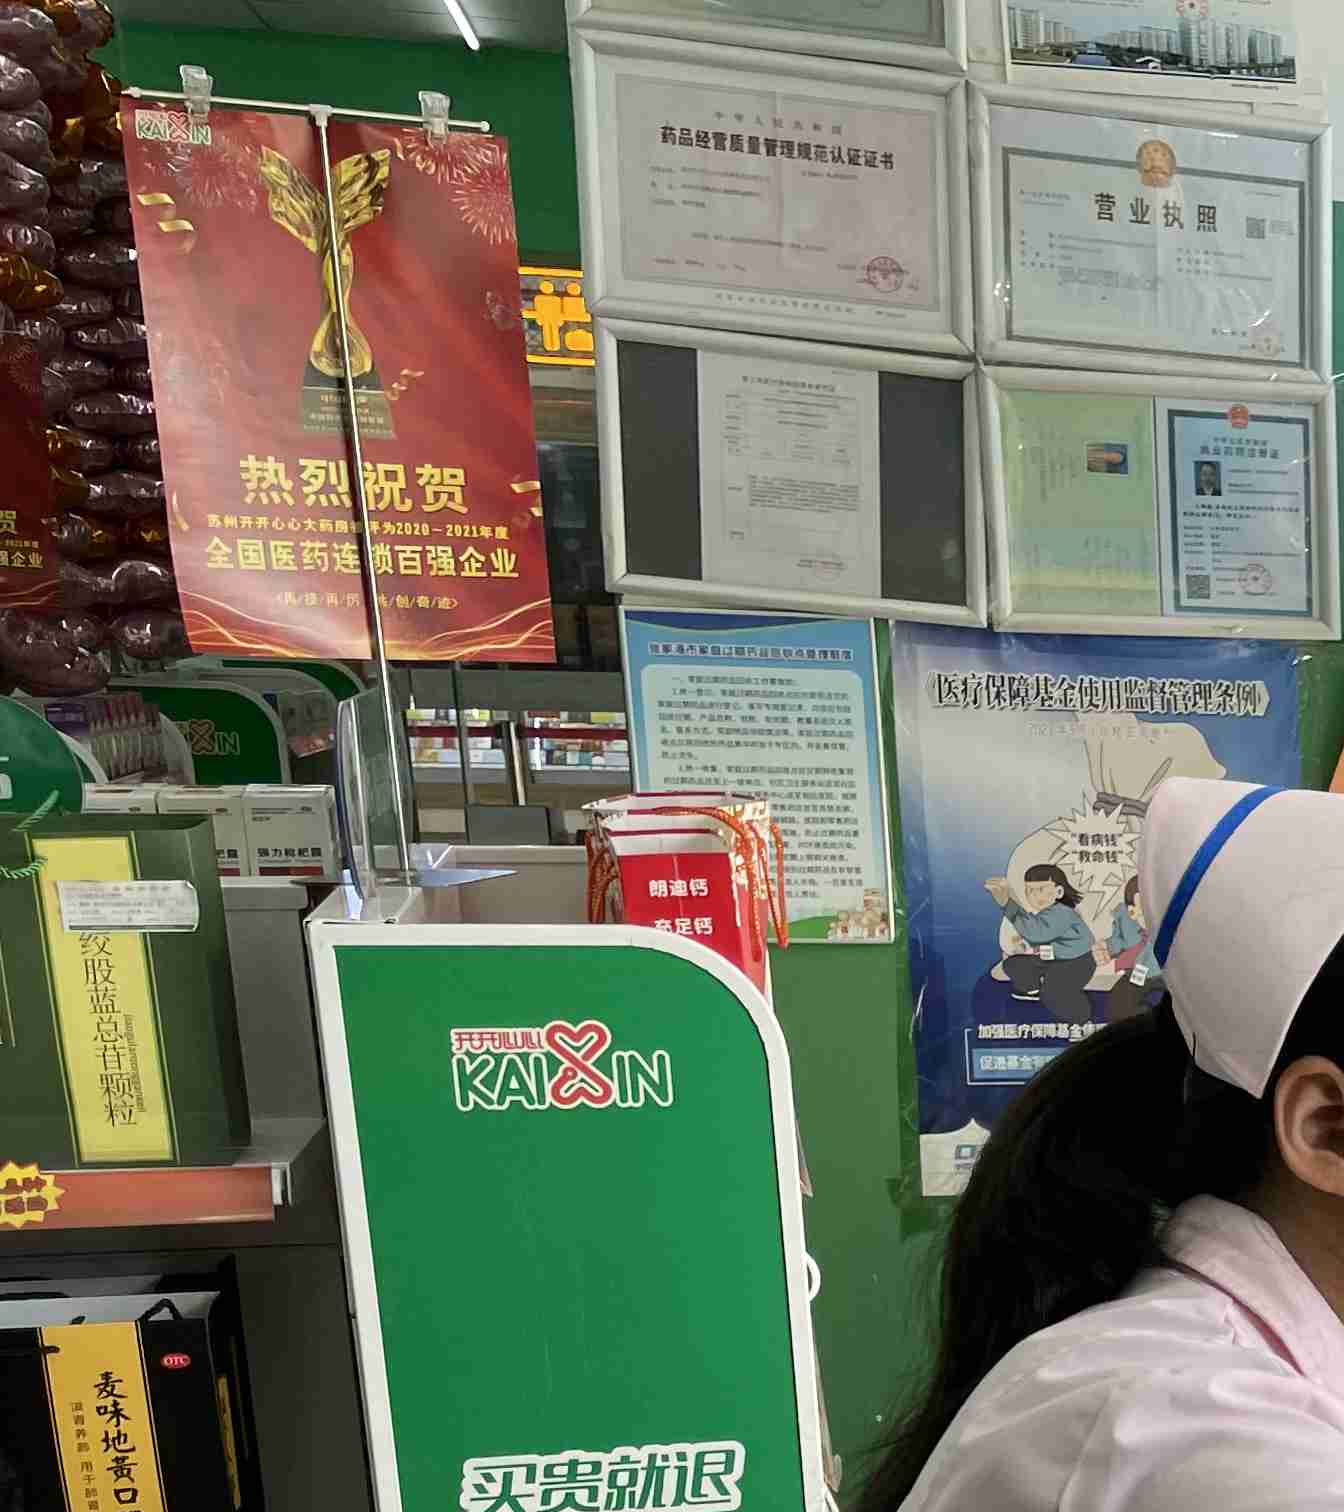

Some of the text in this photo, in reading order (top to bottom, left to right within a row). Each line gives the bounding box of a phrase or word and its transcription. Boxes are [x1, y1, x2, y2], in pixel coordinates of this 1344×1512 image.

[660, 124, 896, 171] 药品经营质量管理规范认证证书
[1093, 191, 1219, 234] 营业执照
[239, 453, 470, 514] 热烈祝贺
[205, 535, 521, 579] 全国医药连锁百强企业
[648, 877, 710, 899] 朗迪钙
[79, 931, 138, 1128] 绞股蓝总苷颗粒
[452, 1020, 675, 1111] KAIXIN
